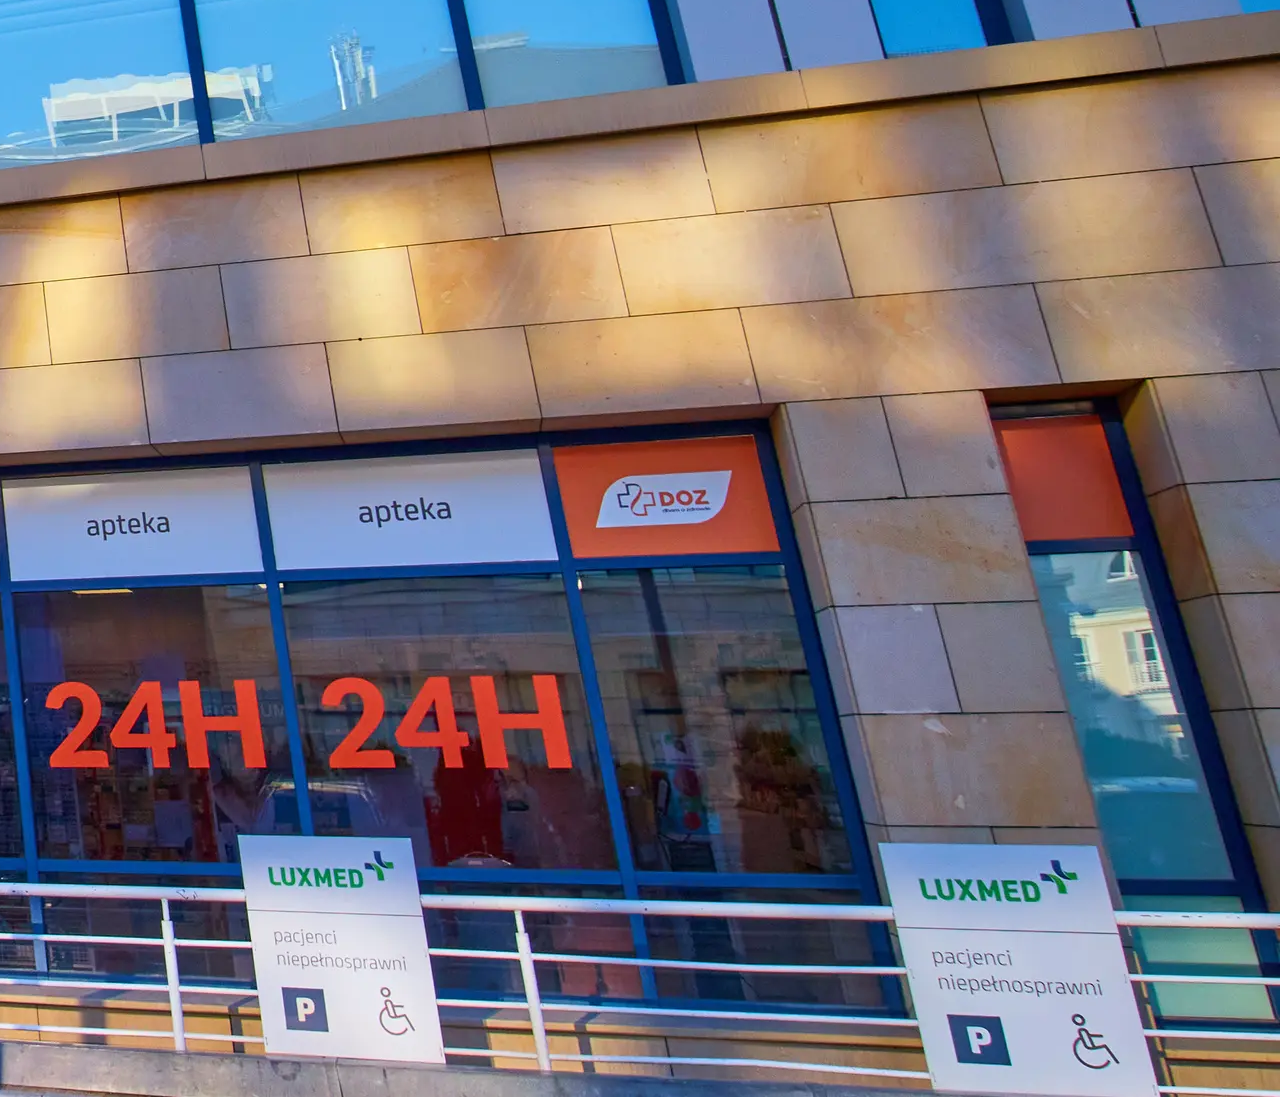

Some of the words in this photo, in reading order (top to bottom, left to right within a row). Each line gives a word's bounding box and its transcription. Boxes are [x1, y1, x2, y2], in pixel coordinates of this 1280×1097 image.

[658, 489, 710, 506] DOZ
[358, 497, 452, 527] apteka
[87, 512, 170, 540] apteka
[45, 679, 267, 769] 24H
[321, 674, 573, 769] 24H
[268, 867, 364, 888] LUXMED
[918, 878, 1041, 902] LUXMED
[274, 929, 337, 946] pacjenci
[277, 952, 408, 972] niepełnosprawni
[931, 948, 1013, 969] pacjenci
[938, 974, 1103, 997] niepełnosprawni
[296, 997, 316, 1022] P
[966, 1026, 992, 1054] P
